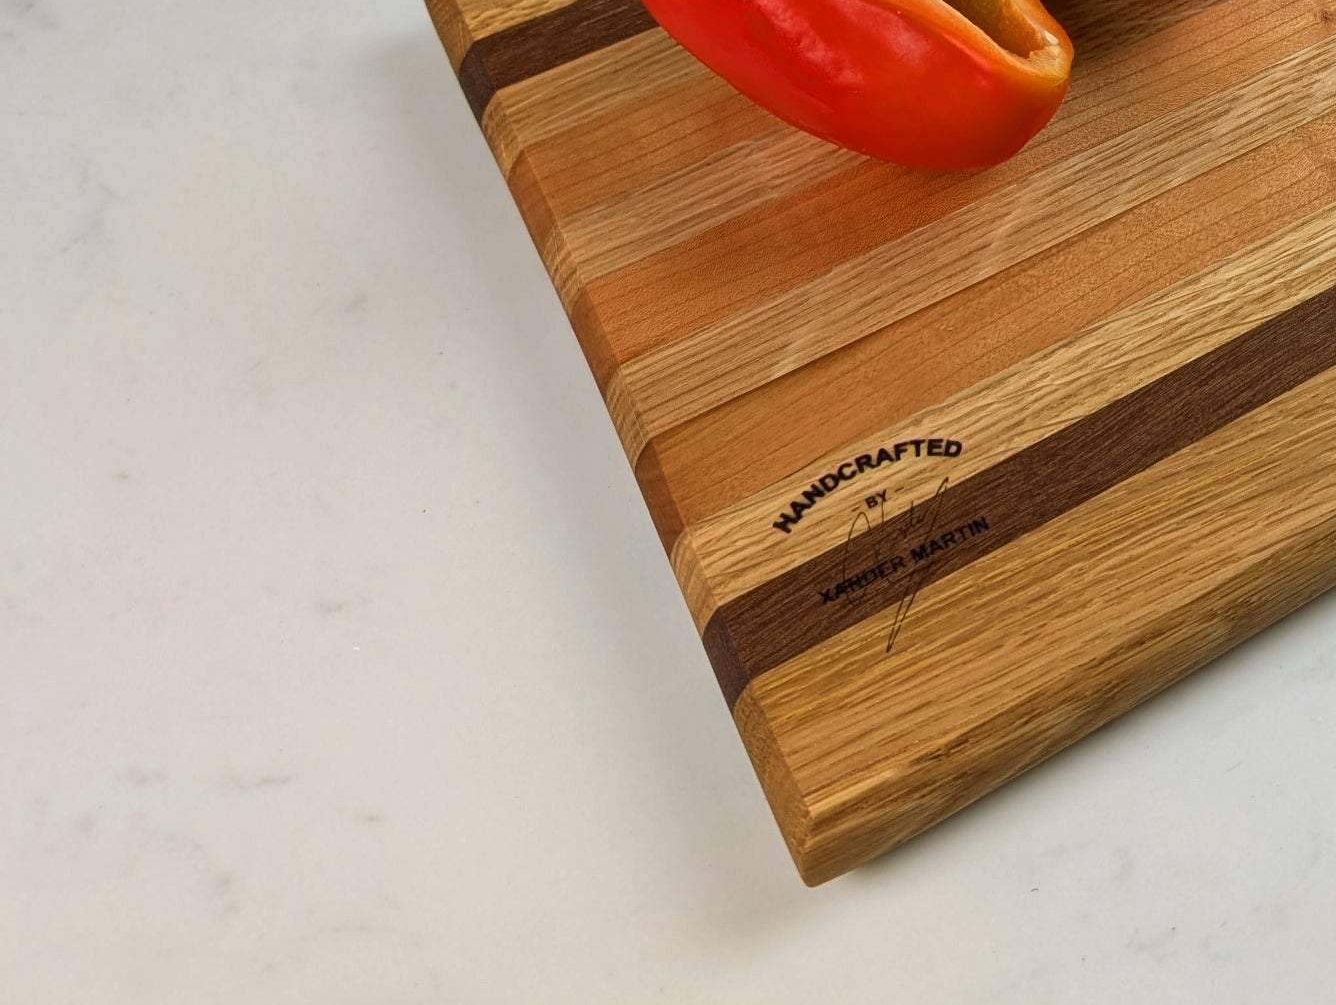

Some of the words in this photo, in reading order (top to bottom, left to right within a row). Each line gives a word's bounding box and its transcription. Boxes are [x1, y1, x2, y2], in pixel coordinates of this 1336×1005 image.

[772, 438, 963, 534] HANDCRAFTED
[864, 489, 888, 509] BY
[818, 555, 906, 606] XANDER
[909, 516, 991, 564] MARTIN
